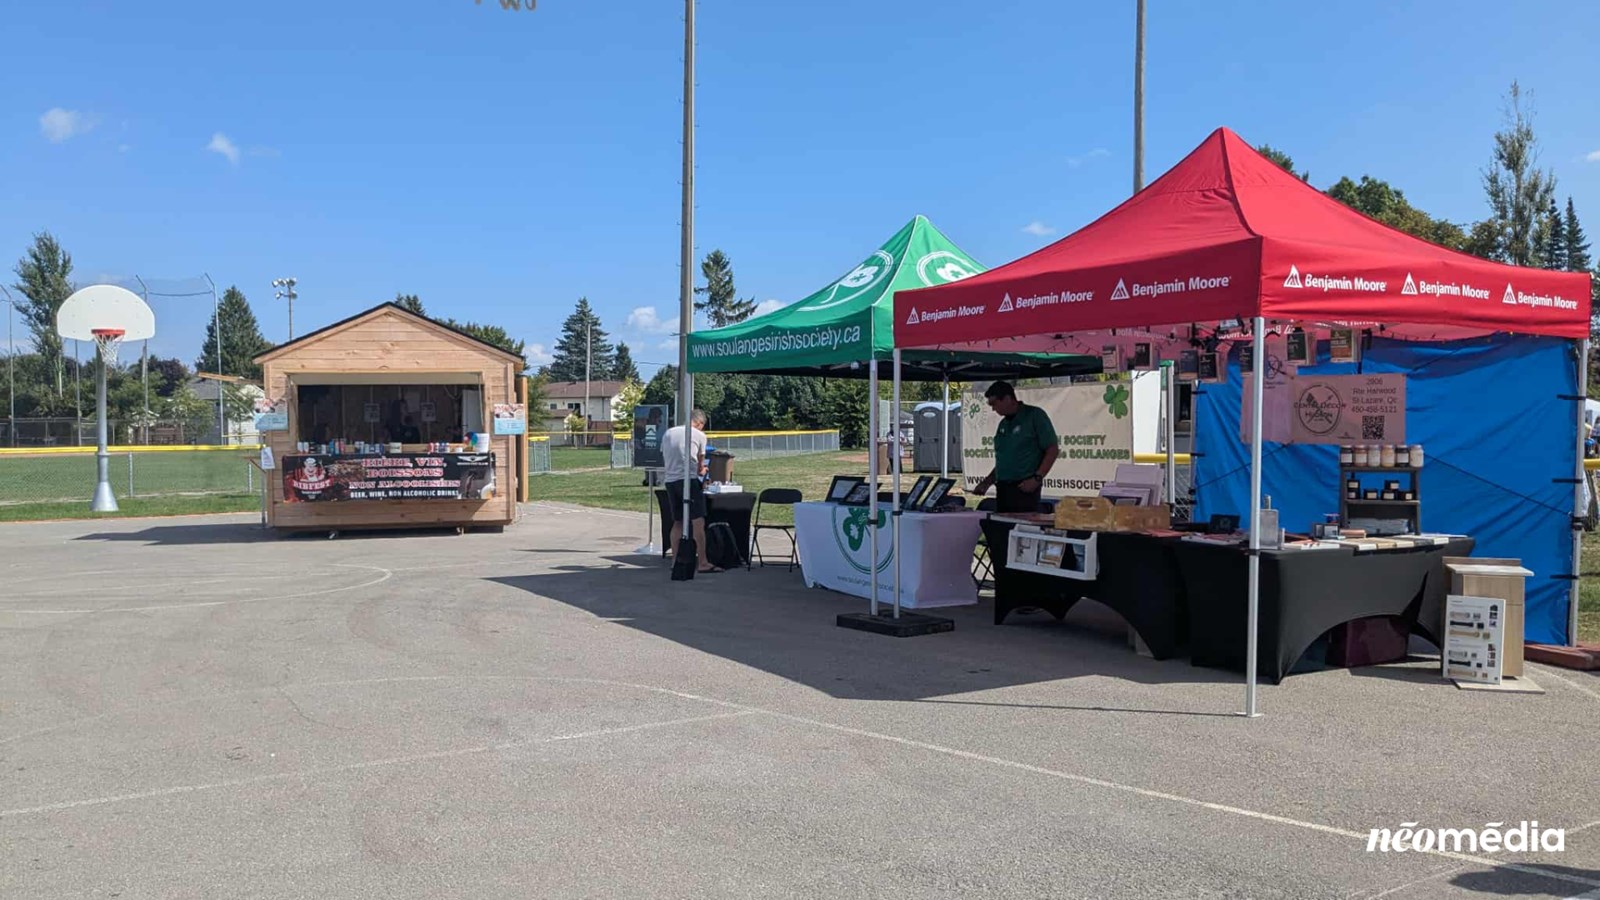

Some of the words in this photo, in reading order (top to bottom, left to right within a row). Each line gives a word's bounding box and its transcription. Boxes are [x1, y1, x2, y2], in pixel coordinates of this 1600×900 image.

[1132, 278, 1186, 298] Benjamin
[1187, 275, 1230, 290] Moore
[1304, 273, 1352, 291] Benjamin
[1354, 277, 1386, 292] Moore
[1419, 280, 1460, 296] Benjamin
[1461, 285, 1490, 300] Moore
[1016, 291, 1059, 309] Benjamin
[1060, 290, 1093, 303] Moore
[1517, 291, 1552, 308] Benjamin
[1553, 296, 1577, 311] Moore
[921, 307, 957, 323] Benjamin
[957, 305, 985, 317] Moore
[691, 325, 861, 358] www.soulangesirishsociety.ca
[1063, 434, 1106, 446] SOCIETY
[964, 446, 995, 459] SOCIÉT
[1069, 448, 1130, 460] SOULANGES
[367, 468, 444, 478] BOISSONS
[349, 481, 376, 489] NON
[377, 478, 461, 488] ALCOOLISÉES
[1043, 478, 1107, 490] IRISHSOCIET
[403, 489, 436, 497] ALCOHOLIC
